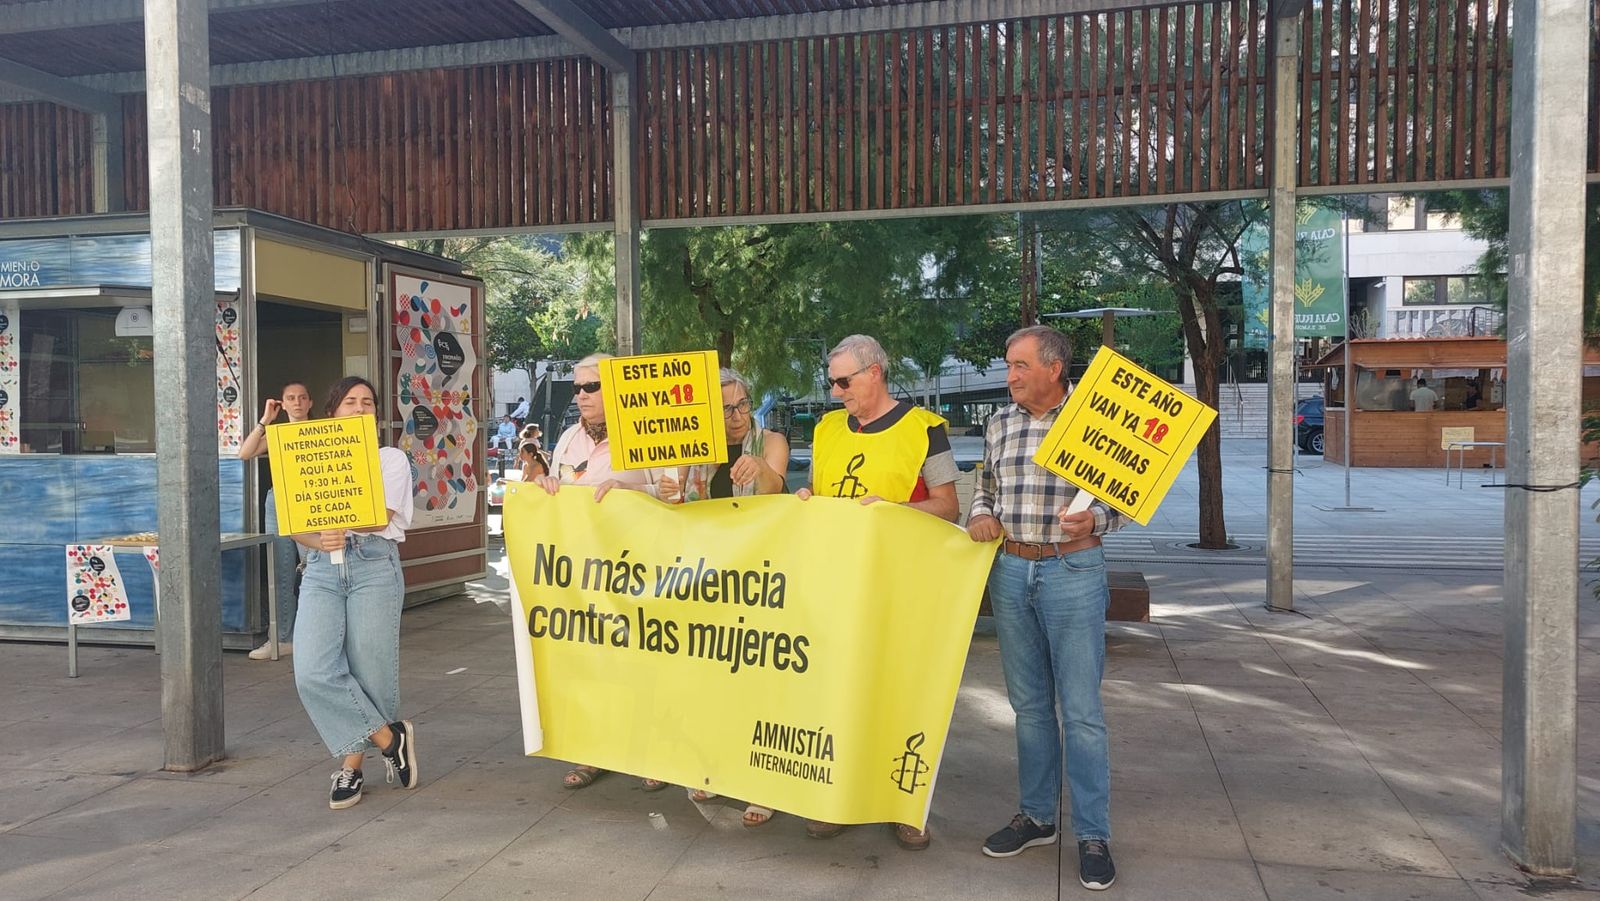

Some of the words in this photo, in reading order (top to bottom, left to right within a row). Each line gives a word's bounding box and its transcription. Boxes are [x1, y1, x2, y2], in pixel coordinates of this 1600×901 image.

[623, 363, 658, 380] ESTE
[663, 358, 691, 378] AÑO
[619, 392, 648, 408] VAN
[652, 390, 670, 406] YA
[670, 384, 694, 404] 18
[1110, 367, 1150, 400] ESTE
[1148, 392, 1183, 417] AÑO
[298, 422, 344, 436] AMNISTÍA
[633, 416, 700, 435] VÍCTIMAS
[1089, 392, 1121, 422] VAN
[1120, 408, 1140, 434] YA
[1142, 417, 1169, 444] 18
[284, 435, 360, 451] INTERNACIONAL
[628, 448, 644, 462] NI
[648, 445, 677, 461] UNA
[680, 440, 710, 458] MÁS
[1081, 426, 1150, 475] VÍCTIMAS
[295, 447, 352, 463] PROTESTARÁ
[300, 463, 324, 476] AQUÍ
[326, 464, 334, 472] A
[336, 462, 352, 472] LAS
[1054, 449, 1075, 469] NI
[1074, 460, 1106, 489] UNA
[1106, 478, 1140, 507] MÁS
[304, 478, 328, 488] 19:30
[332, 476, 342, 485] H.
[344, 475, 356, 484] AL
[295, 491, 312, 502] DÍA
[314, 487, 363, 500] SIGUIENTE
[310, 504, 322, 514] DE
[324, 502, 352, 512] CADA
[306, 514, 360, 527] ASESINATO.
[533, 543, 572, 588] No
[581, 550, 647, 597] más
[654, 556, 786, 610] violencia
[528, 604, 630, 648] contra
[638, 607, 680, 654] las
[687, 616, 810, 674] mujeres
[752, 720, 835, 762] AMNISTÍA
[750, 751, 834, 785] INTERNACIONAL
